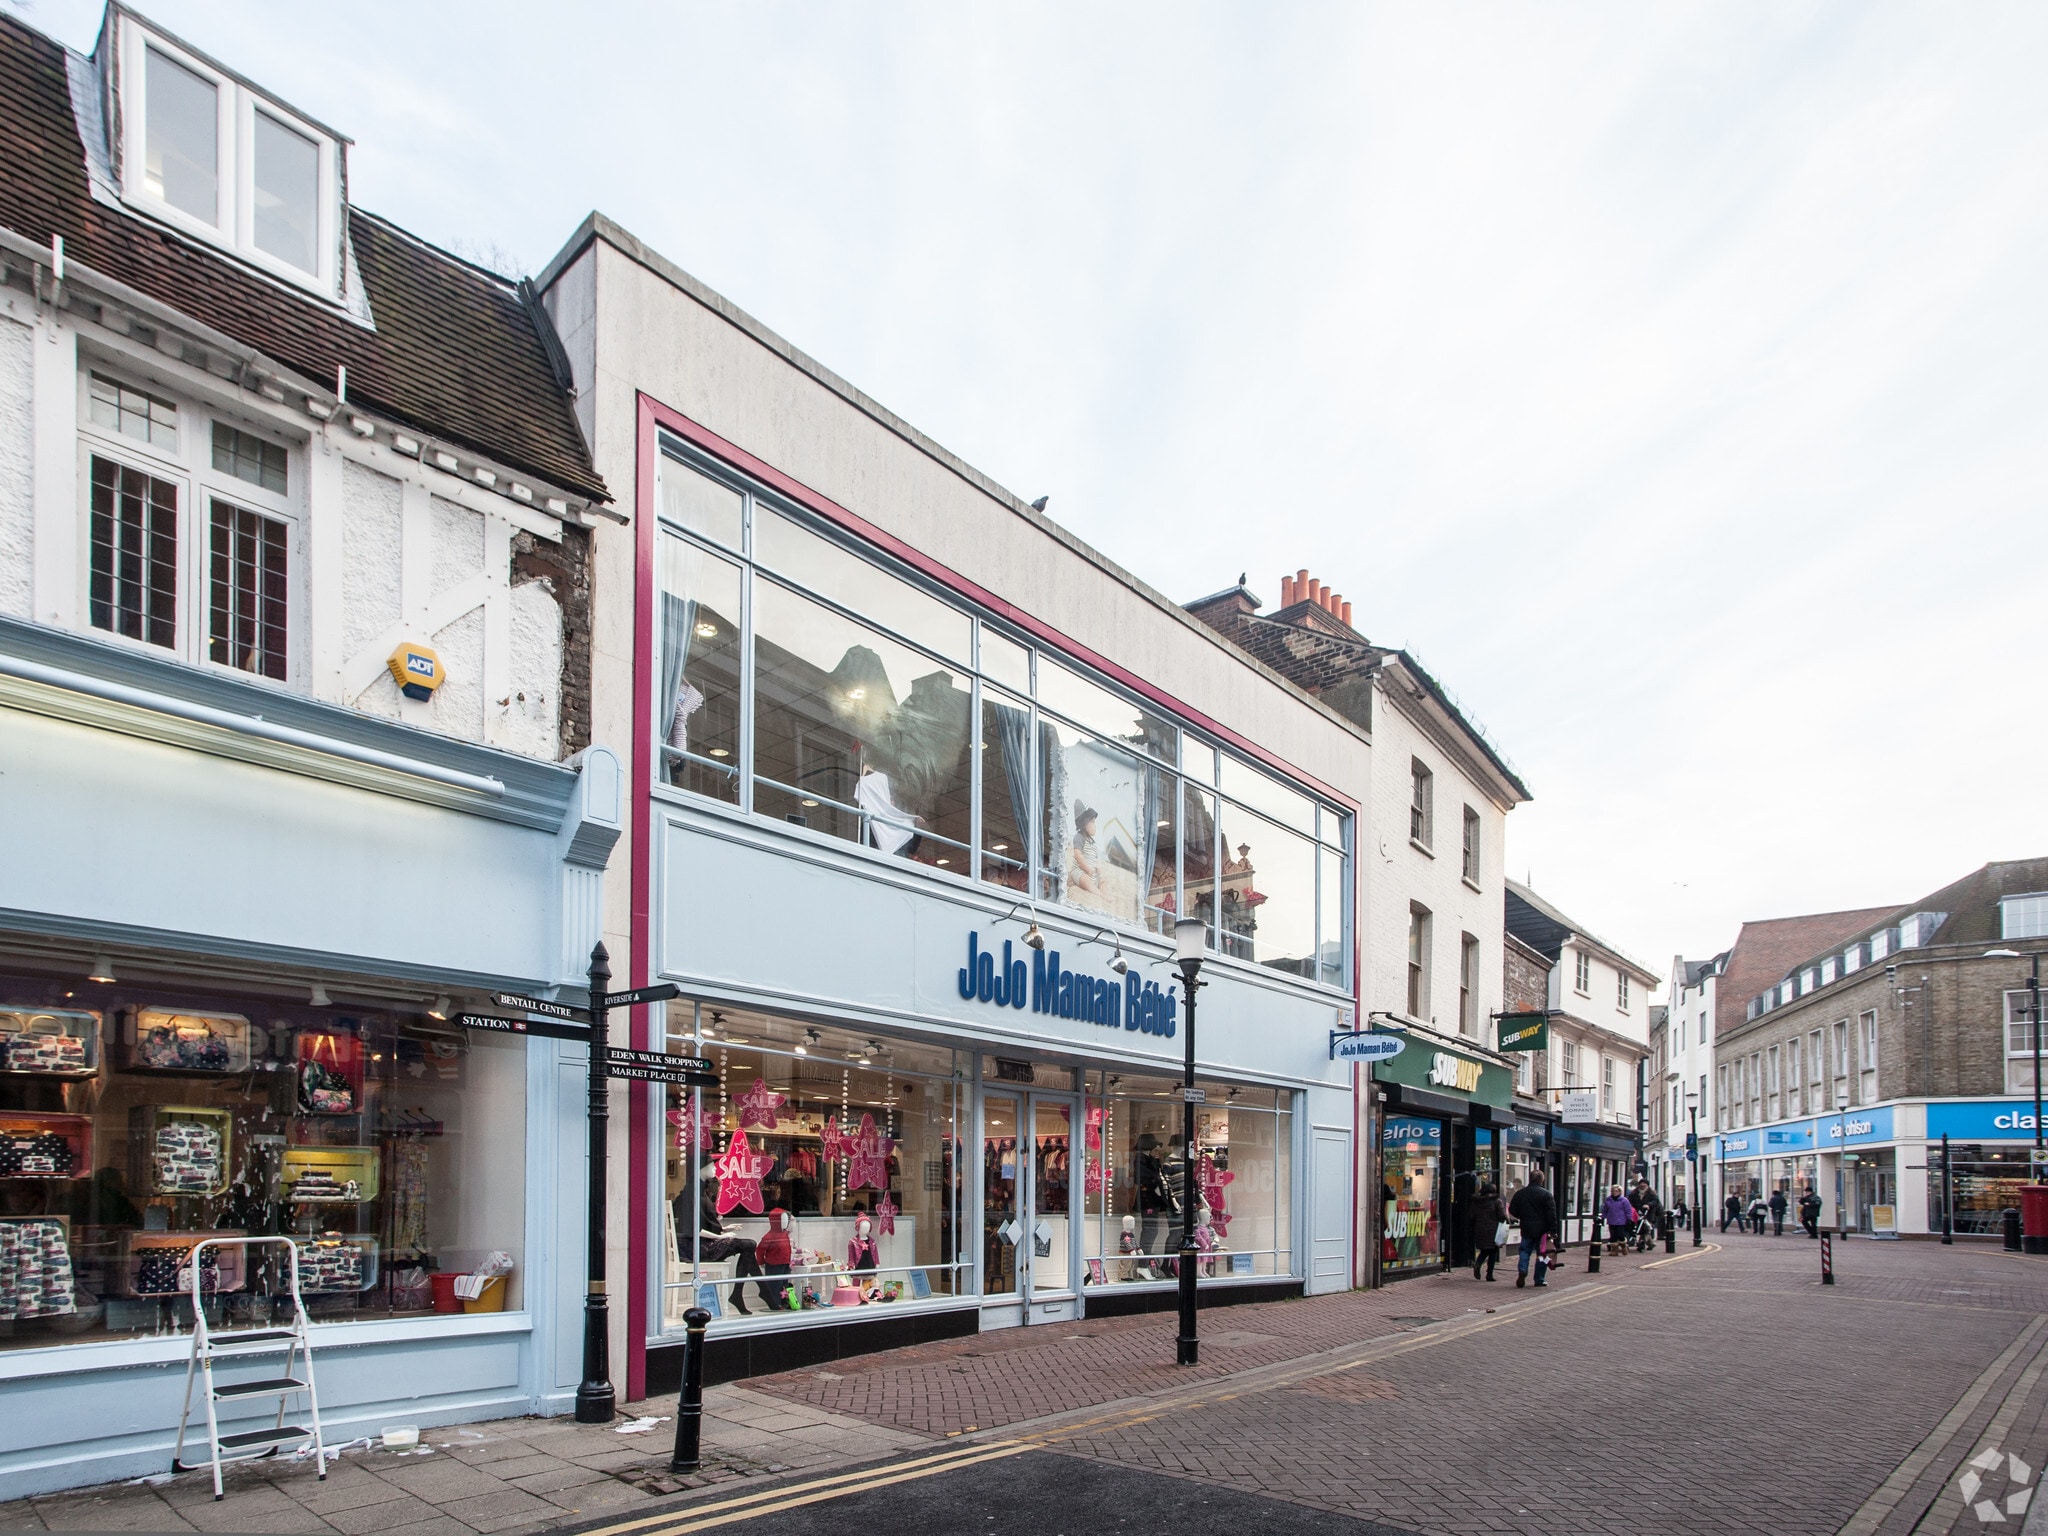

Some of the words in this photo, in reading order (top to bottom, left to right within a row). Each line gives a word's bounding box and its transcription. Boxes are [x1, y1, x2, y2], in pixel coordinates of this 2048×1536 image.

[408, 658, 434, 674] ADT
[959, 931, 1027, 1009] JoJo
[1033, 950, 1121, 1028] Maman
[1125, 970, 1177, 1038] Bébé
[500, 995, 538, 1011] BENTALL
[539, 1003, 572, 1018] CENTRE
[604, 993, 633, 1006] RIVERSIDE
[462, 1015, 511, 1030] STATION
[1501, 1023, 1543, 1047] SUBWAY
[1340, 1044, 1357, 1056] JoJo
[1357, 1043, 1380, 1055] Maman
[611, 1051, 636, 1061] EDEN
[638, 1053, 662, 1064] WALK
[664, 1056, 704, 1069] SHOPPING
[611, 1067, 649, 1079] MARKET
[650, 1071, 677, 1082] PLACE
[1430, 1052, 1483, 1092] SUBWAY
[742, 1094, 777, 1109] SALE
[677, 1112, 712, 1127] SAE
[825, 1131, 841, 1143] SALE
[1830, 1123, 1842, 1138] cla
[1846, 1120, 1872, 1137] ohlson
[851, 1138, 886, 1159] SALE
[719, 1154, 762, 1179] SALE
[1085, 1169, 1101, 1180] SAL
[1384, 1211, 1430, 1238] SUBWAY
